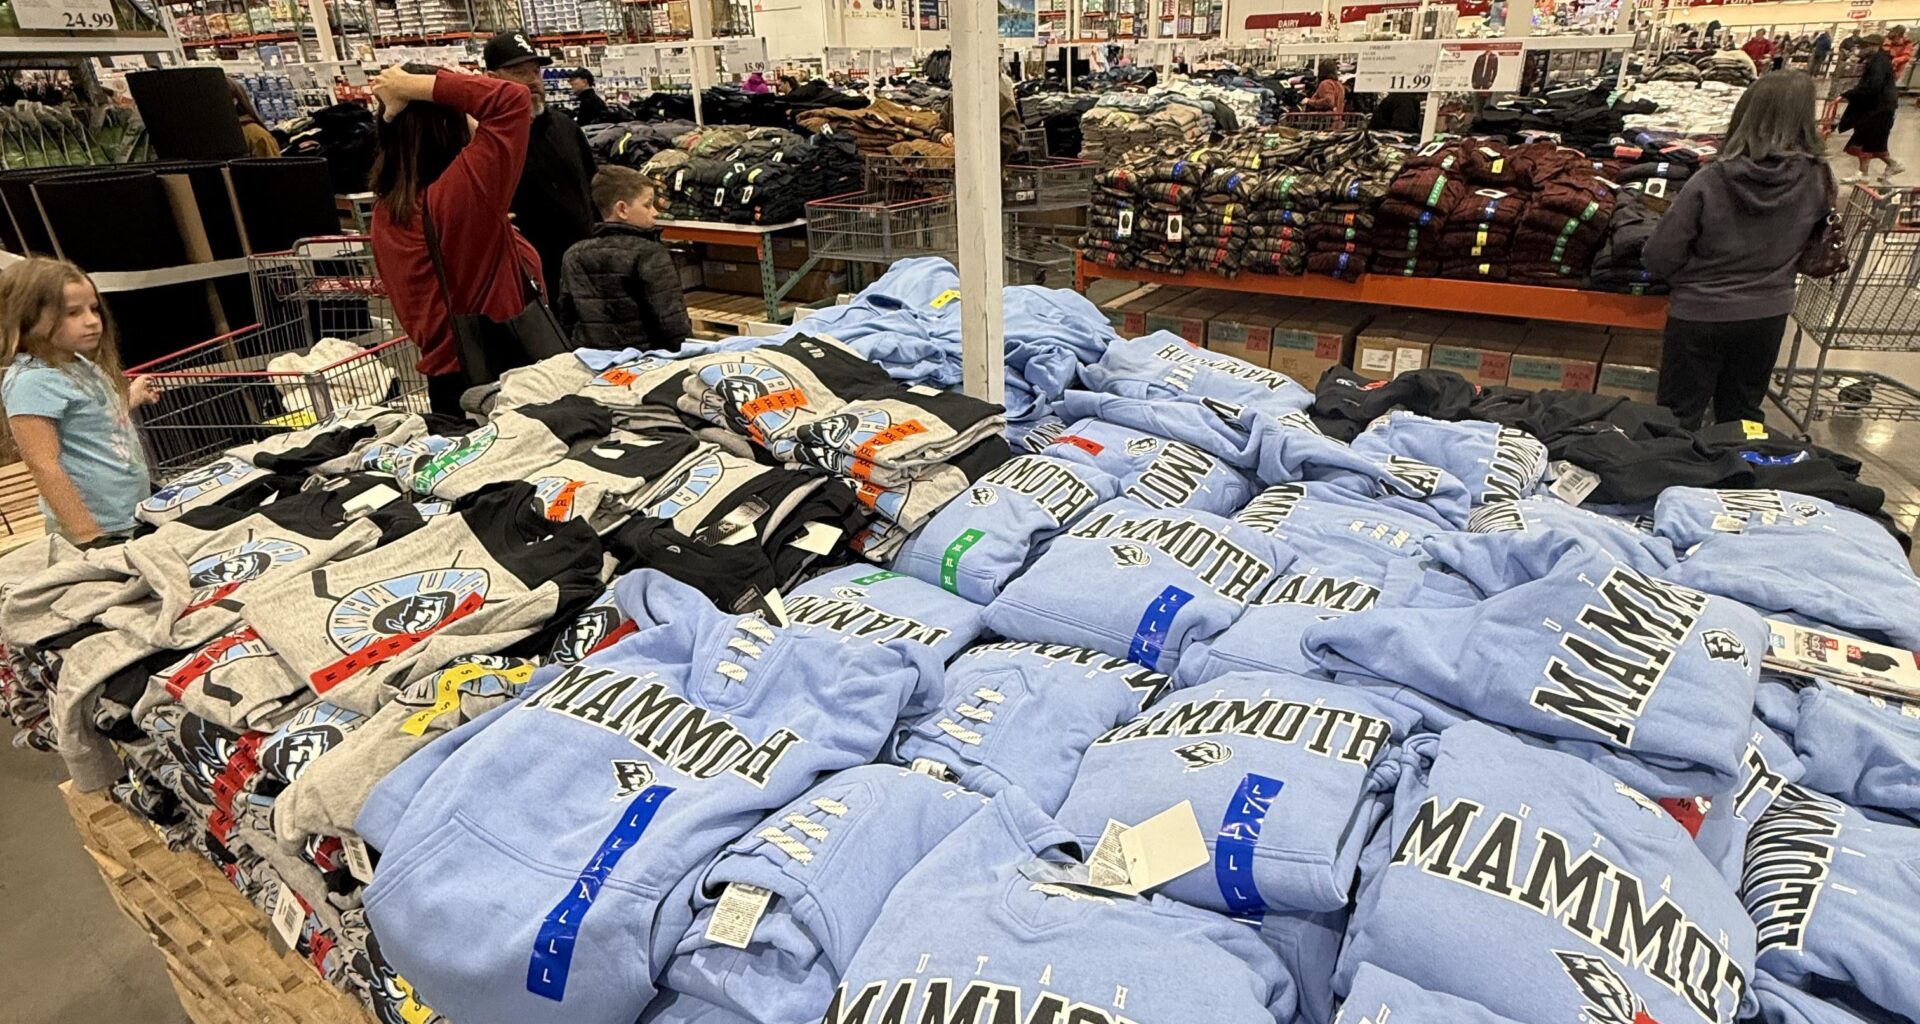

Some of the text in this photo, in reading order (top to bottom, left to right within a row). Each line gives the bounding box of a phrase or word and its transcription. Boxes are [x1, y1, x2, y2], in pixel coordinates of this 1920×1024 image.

[63, 12, 114, 28] 24.99
[1277, 19, 1299, 28] DAIRY
[744, 61, 765, 73] 15.99
[1390, 75, 1431, 89] 11.99
[945, 535, 975, 587] XL XL XL XL
[1149, 621, 1158, 633] L
[1142, 641, 1150, 653] L
[444, 680, 452, 692] S
[1253, 784, 1262, 796] L
[1242, 802, 1252, 814] L
[1677, 798, 1692, 811] M
[630, 815, 638, 828] L
[612, 838, 622, 849] L
[1230, 856, 1238, 871] L
[559, 910, 568, 924] L
[549, 940, 558, 954] L
[543, 968, 552, 984] L
